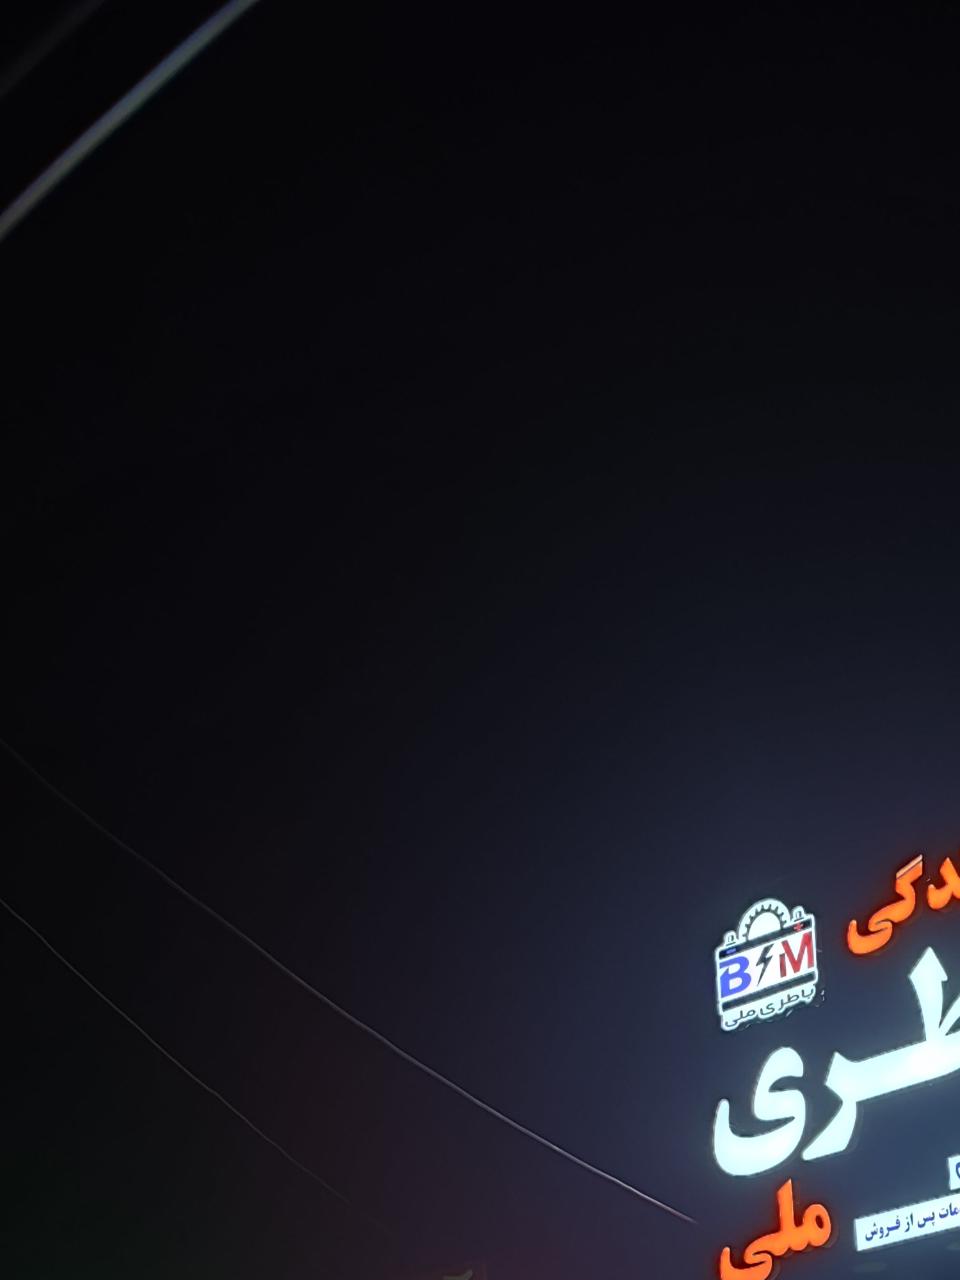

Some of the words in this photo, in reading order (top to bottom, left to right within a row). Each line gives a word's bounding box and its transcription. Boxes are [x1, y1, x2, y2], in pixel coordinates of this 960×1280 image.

[760, 989, 814, 1016] باطری
[725, 1009, 756, 1028] ملی
[904, 1214, 914, 1232] از
[917, 1210, 935, 1228] پس
[865, 1217, 901, 1241] فروش
